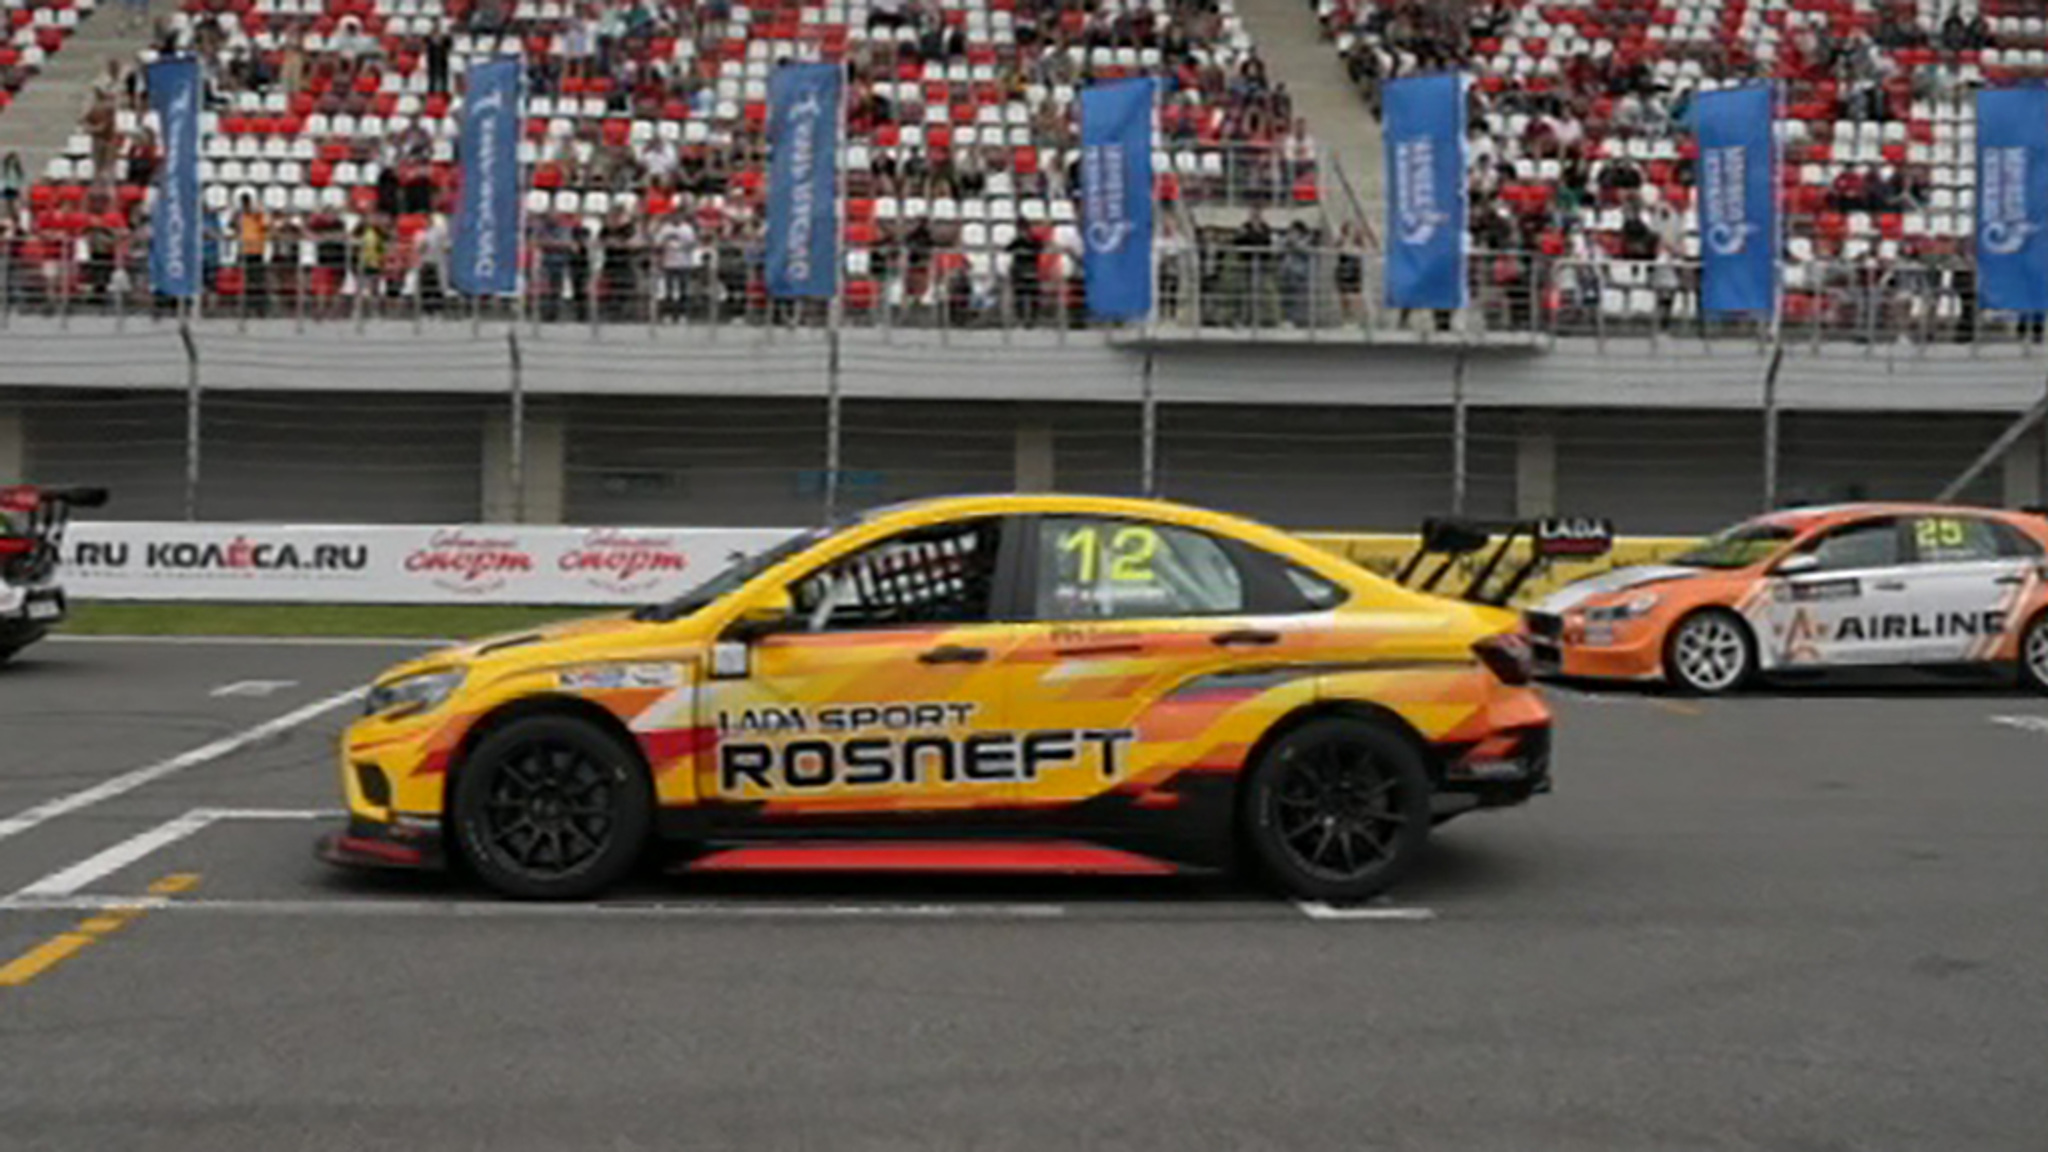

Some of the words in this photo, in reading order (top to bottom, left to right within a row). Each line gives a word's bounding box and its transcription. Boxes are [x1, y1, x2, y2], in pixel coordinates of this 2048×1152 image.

[1539, 519, 1606, 538] LADA
[1915, 518, 1964, 546] 25
[1061, 526, 1155, 582] 12
[1833, 610, 2008, 642] AIRLINE
[719, 708, 806, 733] LADA
[818, 703, 974, 731] SPORT
[719, 729, 1134, 790] ROSNEFT
